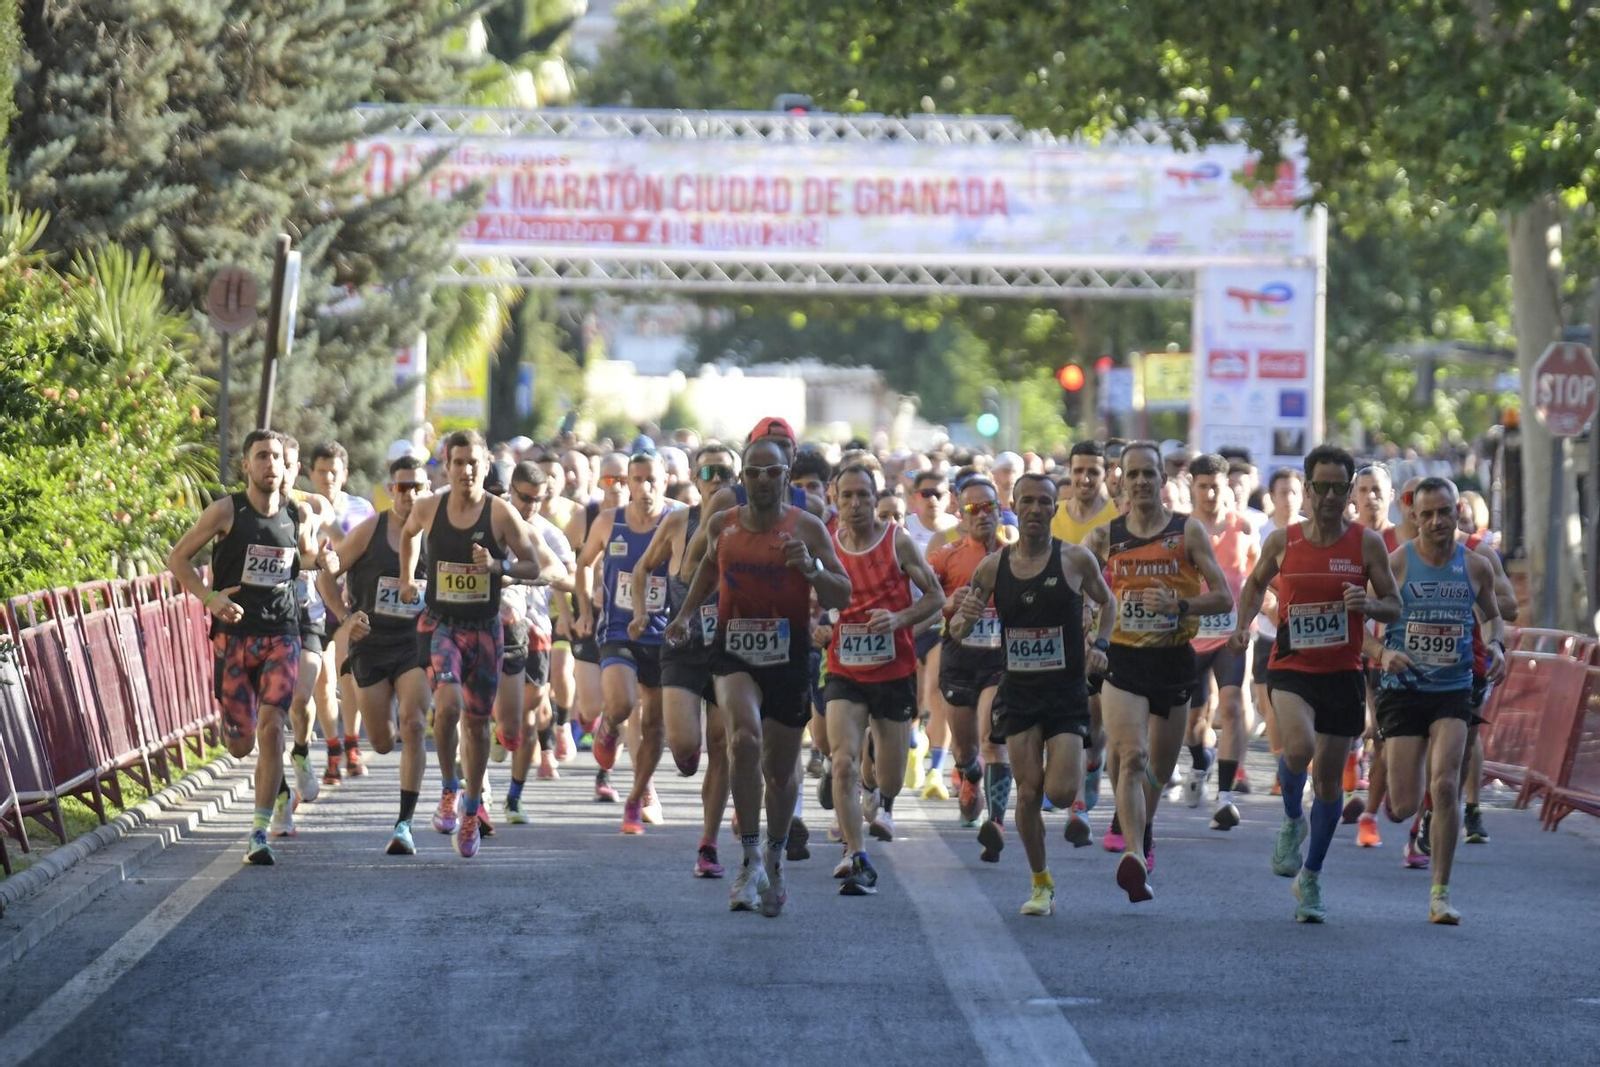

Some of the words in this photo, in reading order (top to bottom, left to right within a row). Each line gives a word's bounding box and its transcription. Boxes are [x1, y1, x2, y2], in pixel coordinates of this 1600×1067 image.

[512, 165, 663, 212] MARATÓN
[673, 173, 792, 215] CIUDAD
[803, 175, 843, 216] DE
[854, 176, 1008, 218] GRANADA
[1540, 372, 1597, 408] STOP
[247, 556, 286, 574] 2467
[1329, 563, 1363, 574] VAMPIROS
[445, 574, 477, 590] 160
[379, 588, 420, 606] 21
[621, 583, 659, 601] 15
[1440, 588, 1469, 598] ULSA
[1199, 613, 1231, 627] 333
[1293, 614, 1340, 635] 1504
[730, 632, 779, 651] 5091
[842, 635, 887, 652] 4712
[1009, 639, 1056, 657] 4644
[1408, 635, 1455, 653] 5399
